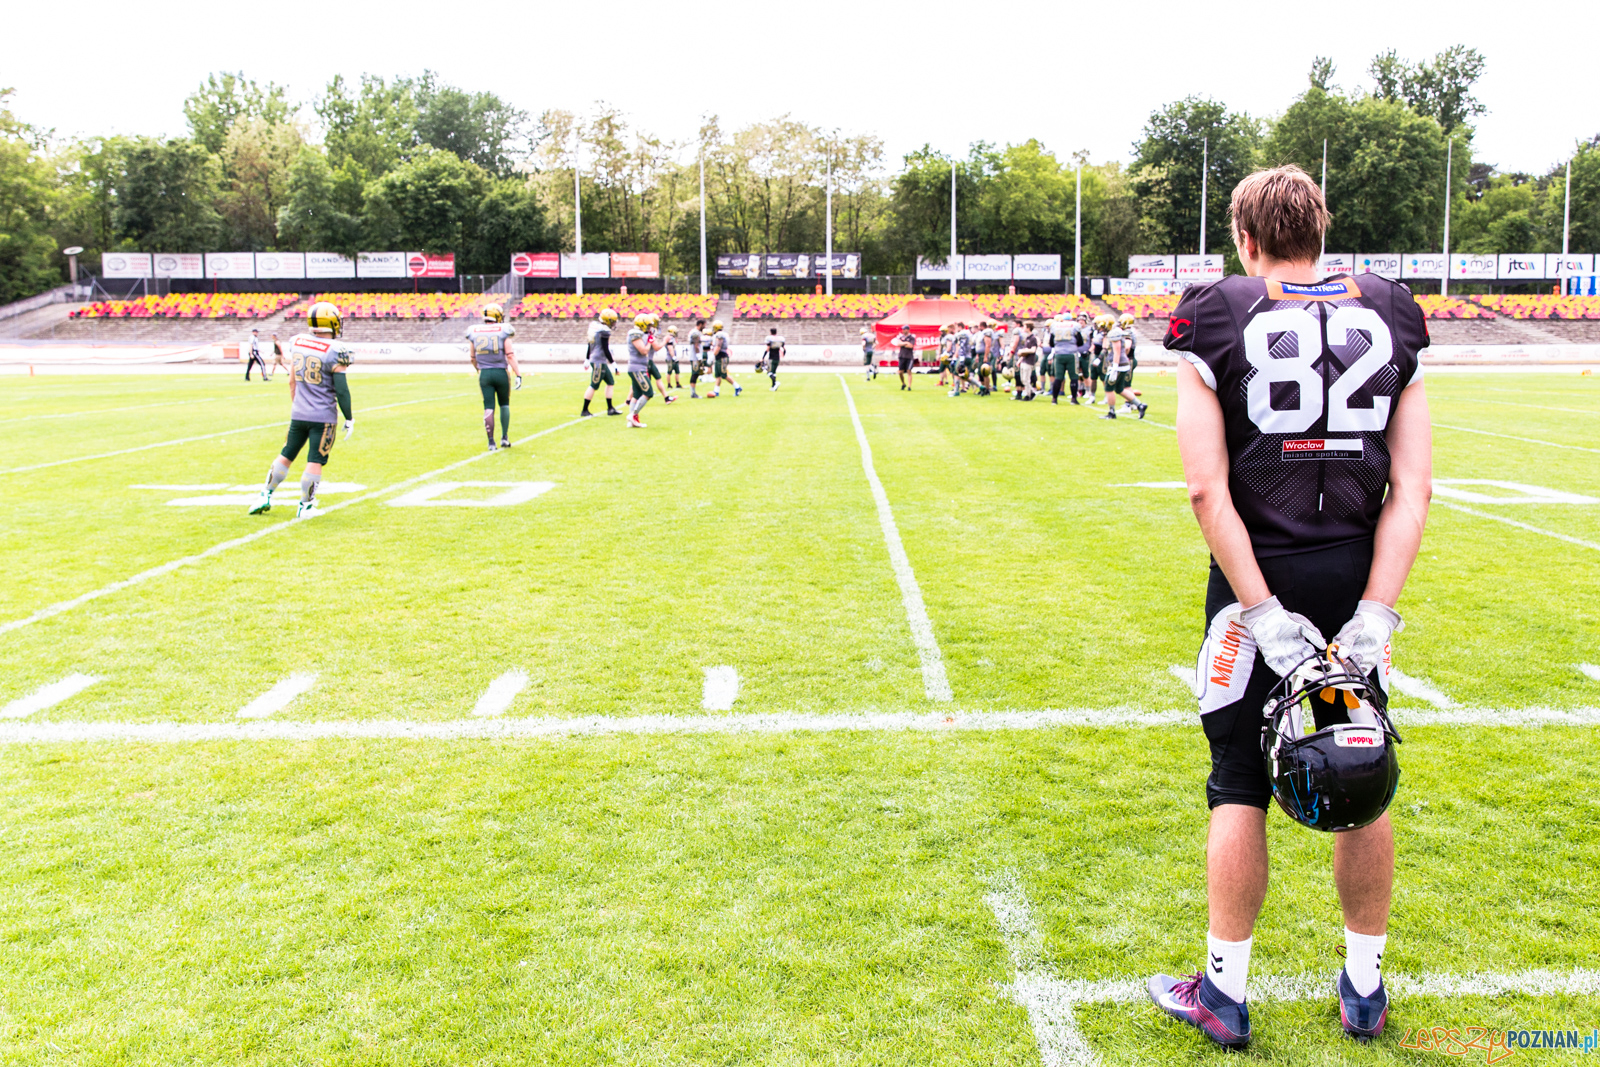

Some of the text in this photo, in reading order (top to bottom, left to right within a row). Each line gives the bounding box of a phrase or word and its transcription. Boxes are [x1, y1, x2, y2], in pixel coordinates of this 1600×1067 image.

[1374, 259, 1397, 270] mjp
[1470, 259, 1494, 270] mjp
[1124, 281, 1145, 290] mjp
[476, 335, 499, 354] 21
[292, 352, 322, 385] 28
[1243, 306, 1393, 435] 82
[1347, 736, 1374, 746] Riddell
